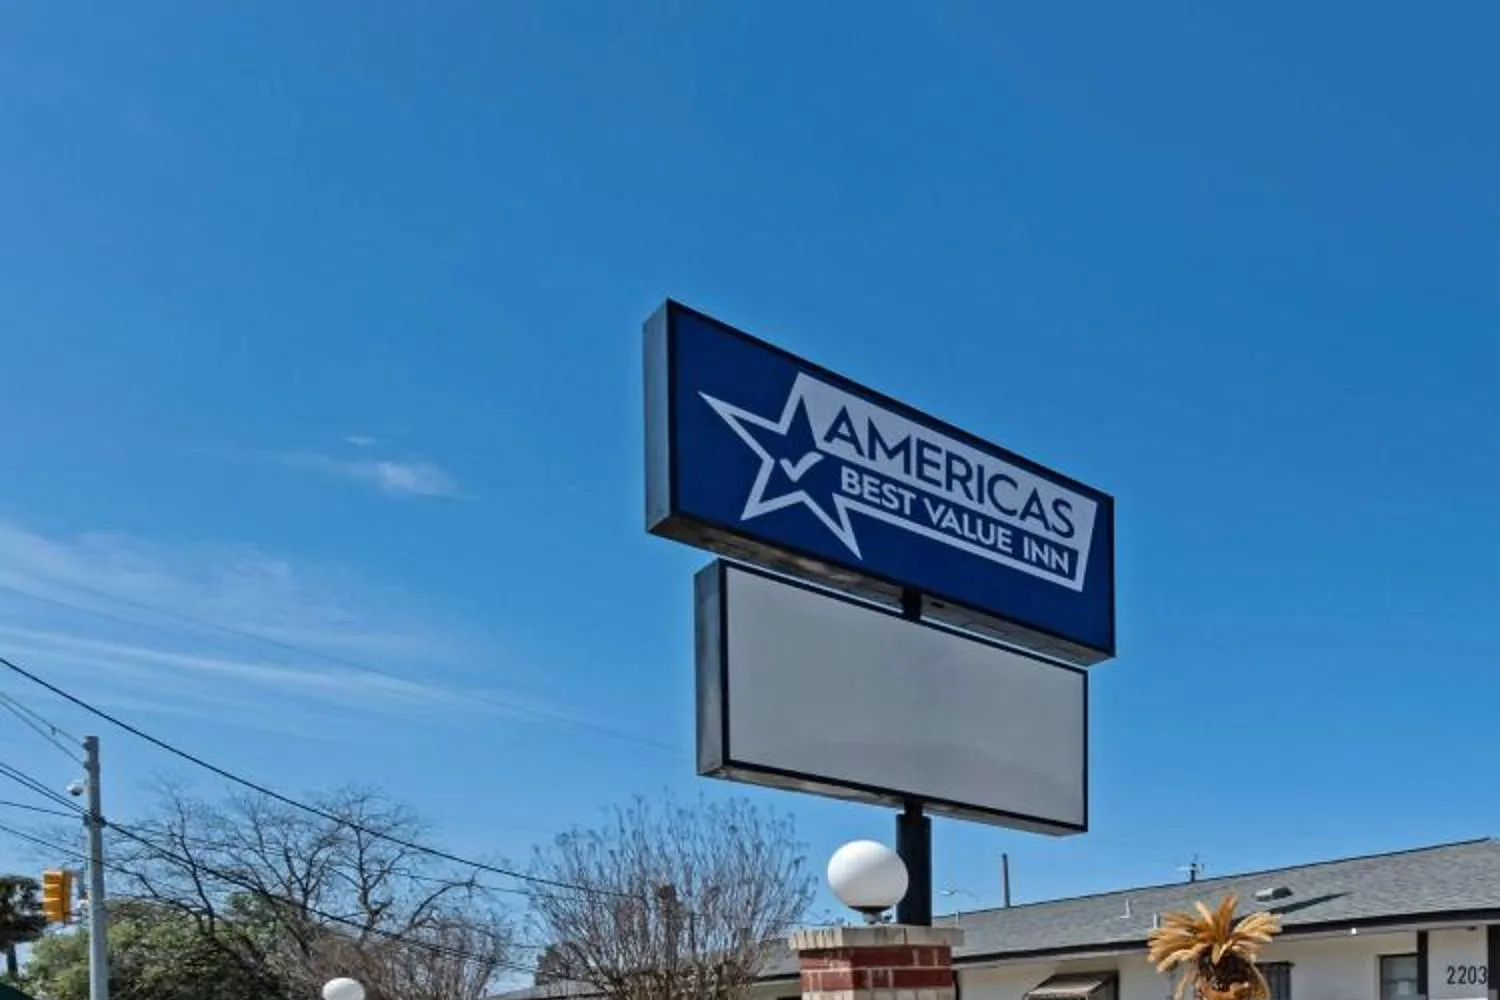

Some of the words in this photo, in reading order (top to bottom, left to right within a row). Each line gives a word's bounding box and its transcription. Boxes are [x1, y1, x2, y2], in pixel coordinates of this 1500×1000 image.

[823, 405, 1075, 539] AMERICAS
[841, 465, 917, 515] BEST
[923, 497, 1013, 554] VALUE
[1023, 534, 1070, 575] INN
[1446, 965, 1488, 985] 2203
